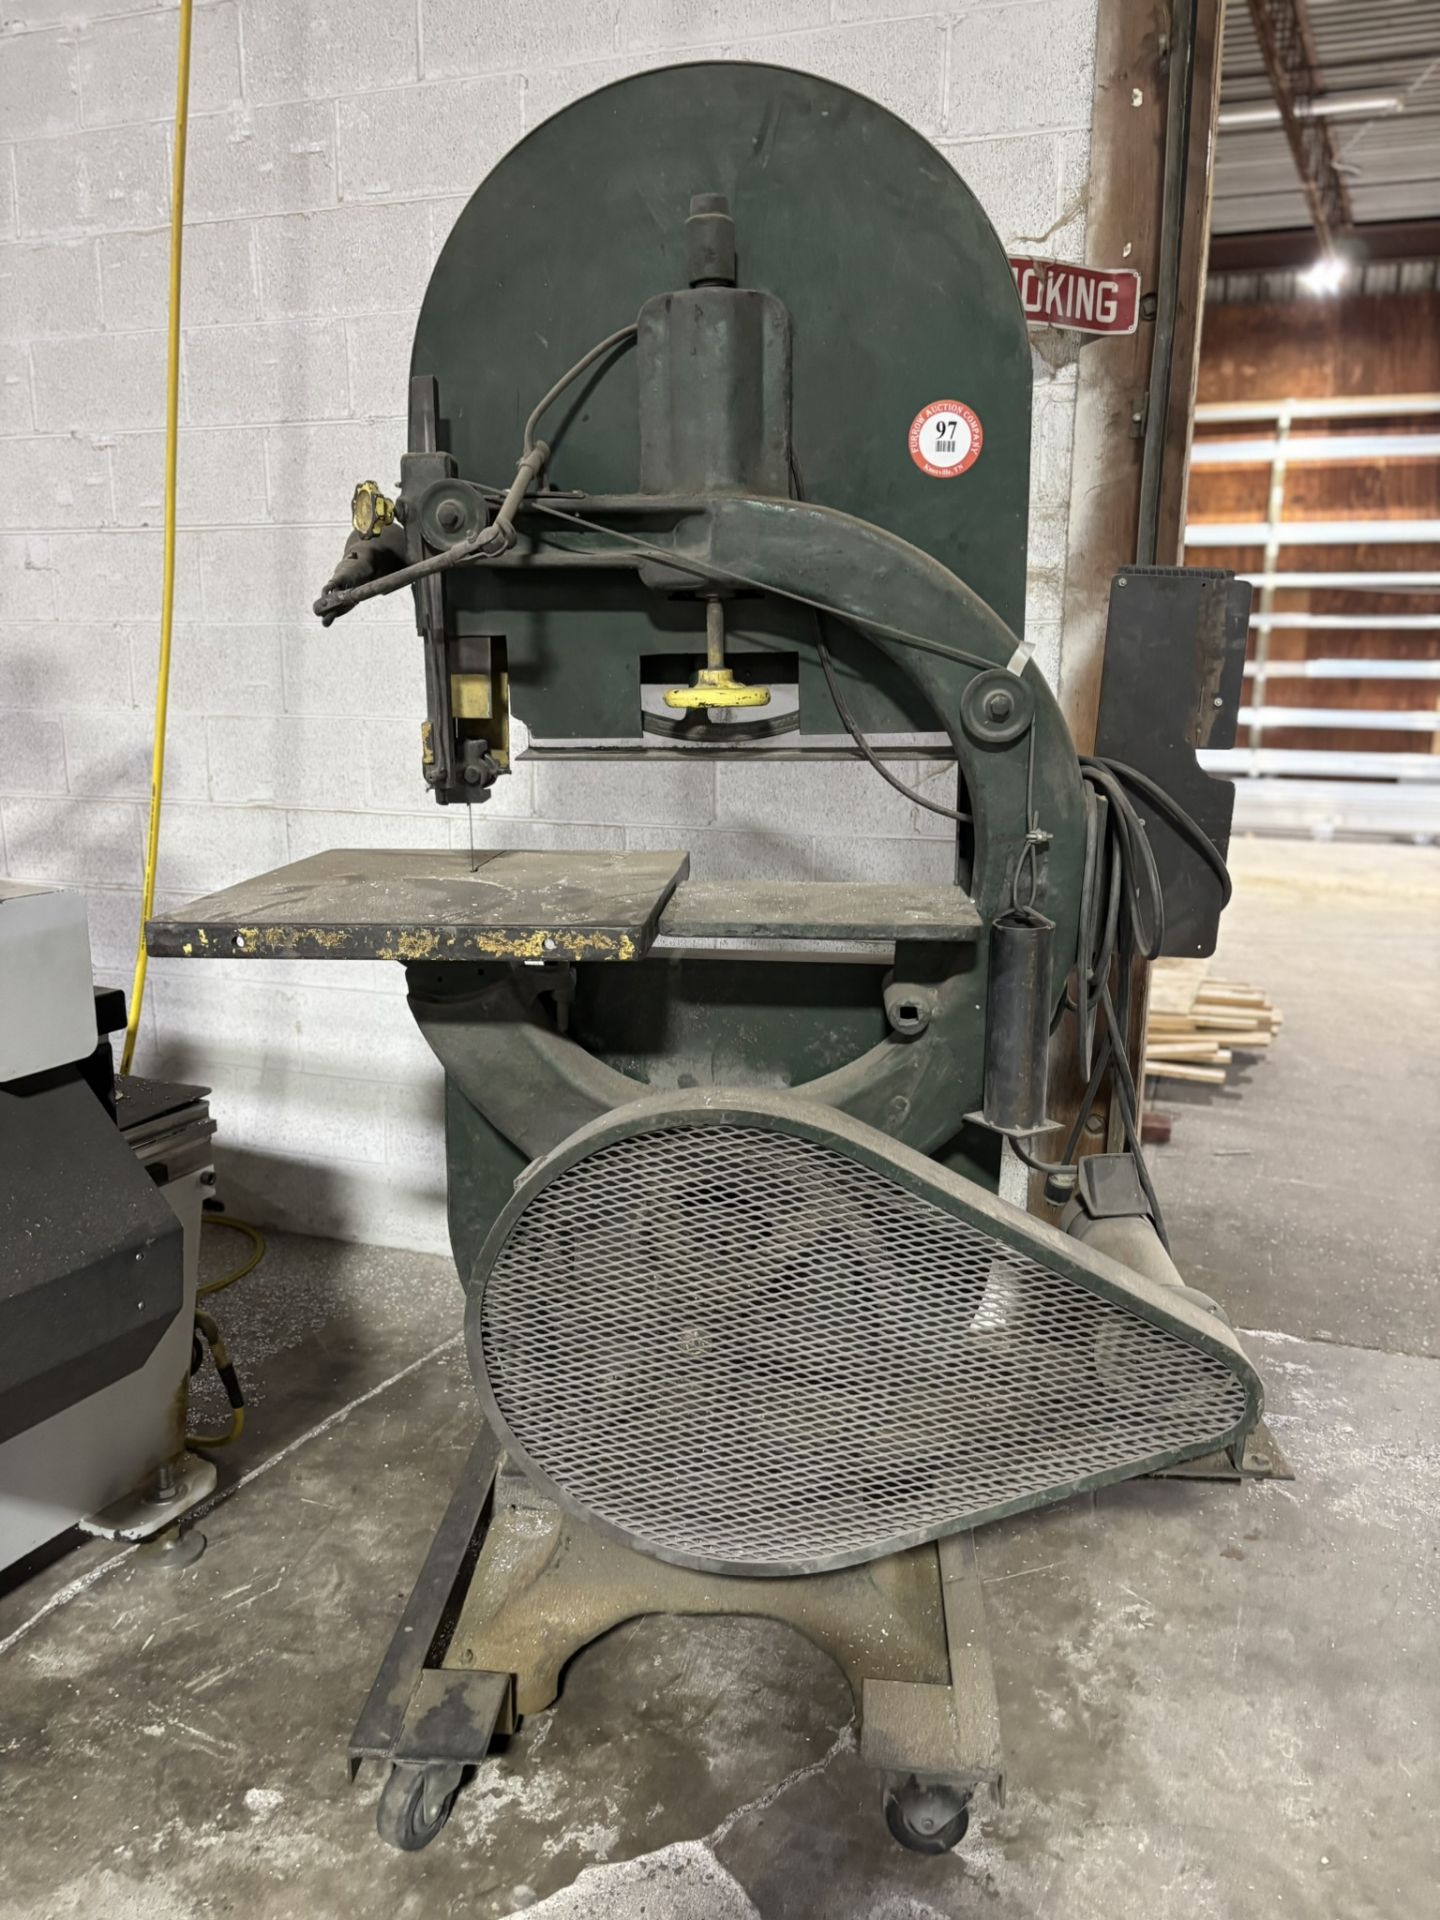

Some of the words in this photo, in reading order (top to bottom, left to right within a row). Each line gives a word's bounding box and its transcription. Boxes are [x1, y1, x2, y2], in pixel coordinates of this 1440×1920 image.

[910, 414, 925, 454] FURROW
[926, 404, 963, 417] AUCTION
[964, 411, 980, 455] COMPANY
[936, 420, 957, 440] 97
